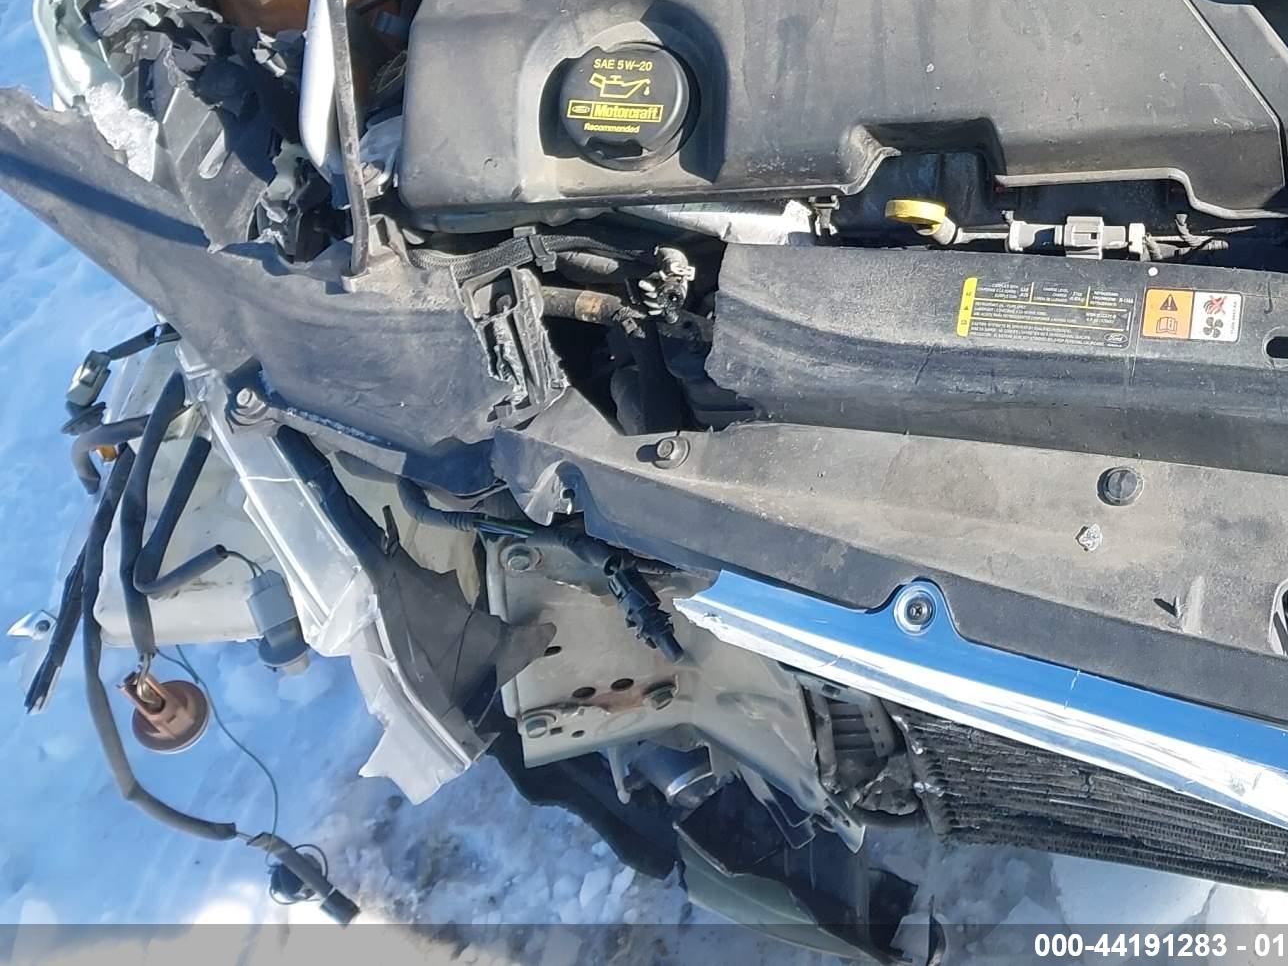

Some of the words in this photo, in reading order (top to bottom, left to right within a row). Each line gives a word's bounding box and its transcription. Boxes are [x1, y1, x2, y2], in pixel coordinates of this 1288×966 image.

[593, 58, 615, 69] SAE
[617, 59, 653, 71] 5W-20
[594, 103, 659, 120] Motorcraft
[584, 122, 641, 133] Recommended
